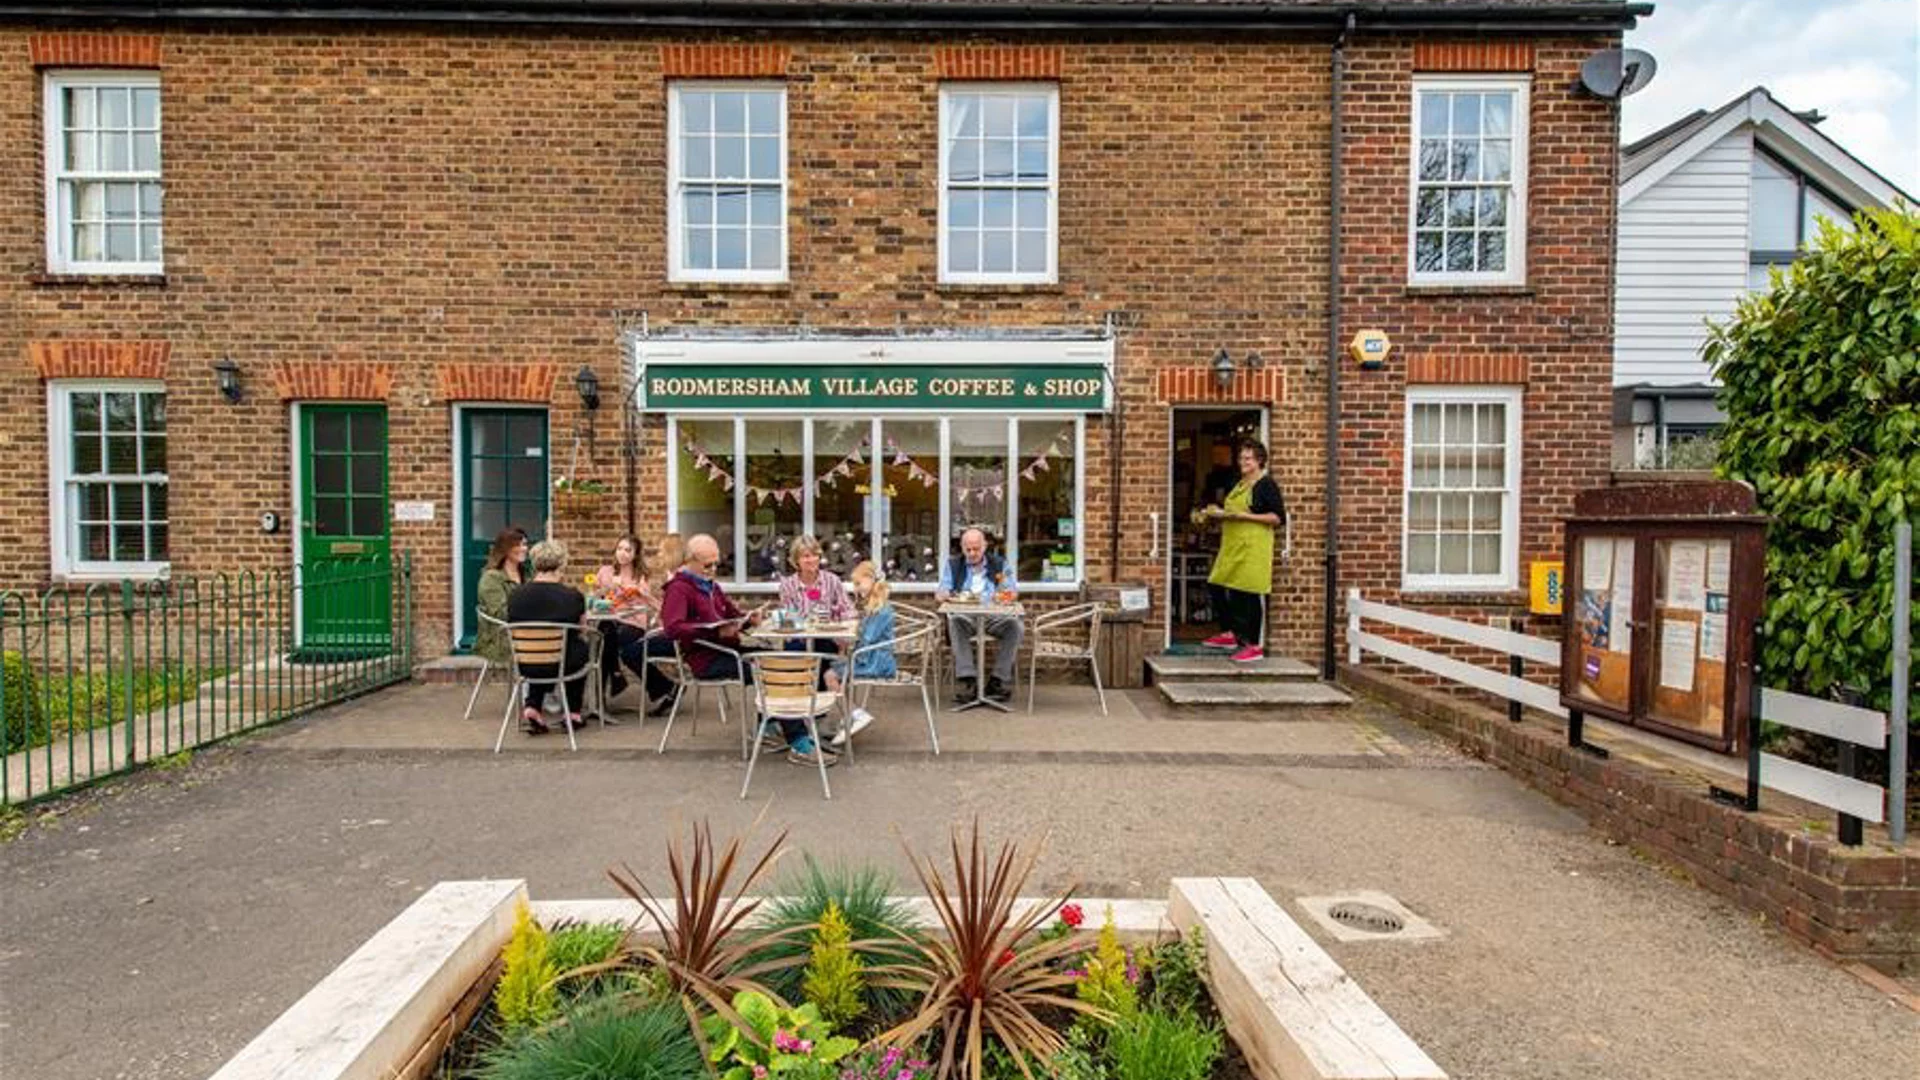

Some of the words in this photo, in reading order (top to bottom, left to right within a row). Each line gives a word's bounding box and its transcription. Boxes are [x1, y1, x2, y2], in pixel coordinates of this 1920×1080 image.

[651, 378, 811, 396] RODMERSHAM
[823, 378, 918, 396] VILLAGE
[929, 378, 1015, 396] COFFEE
[1023, 383, 1038, 396] &
[1044, 378, 1102, 396] SHOP
